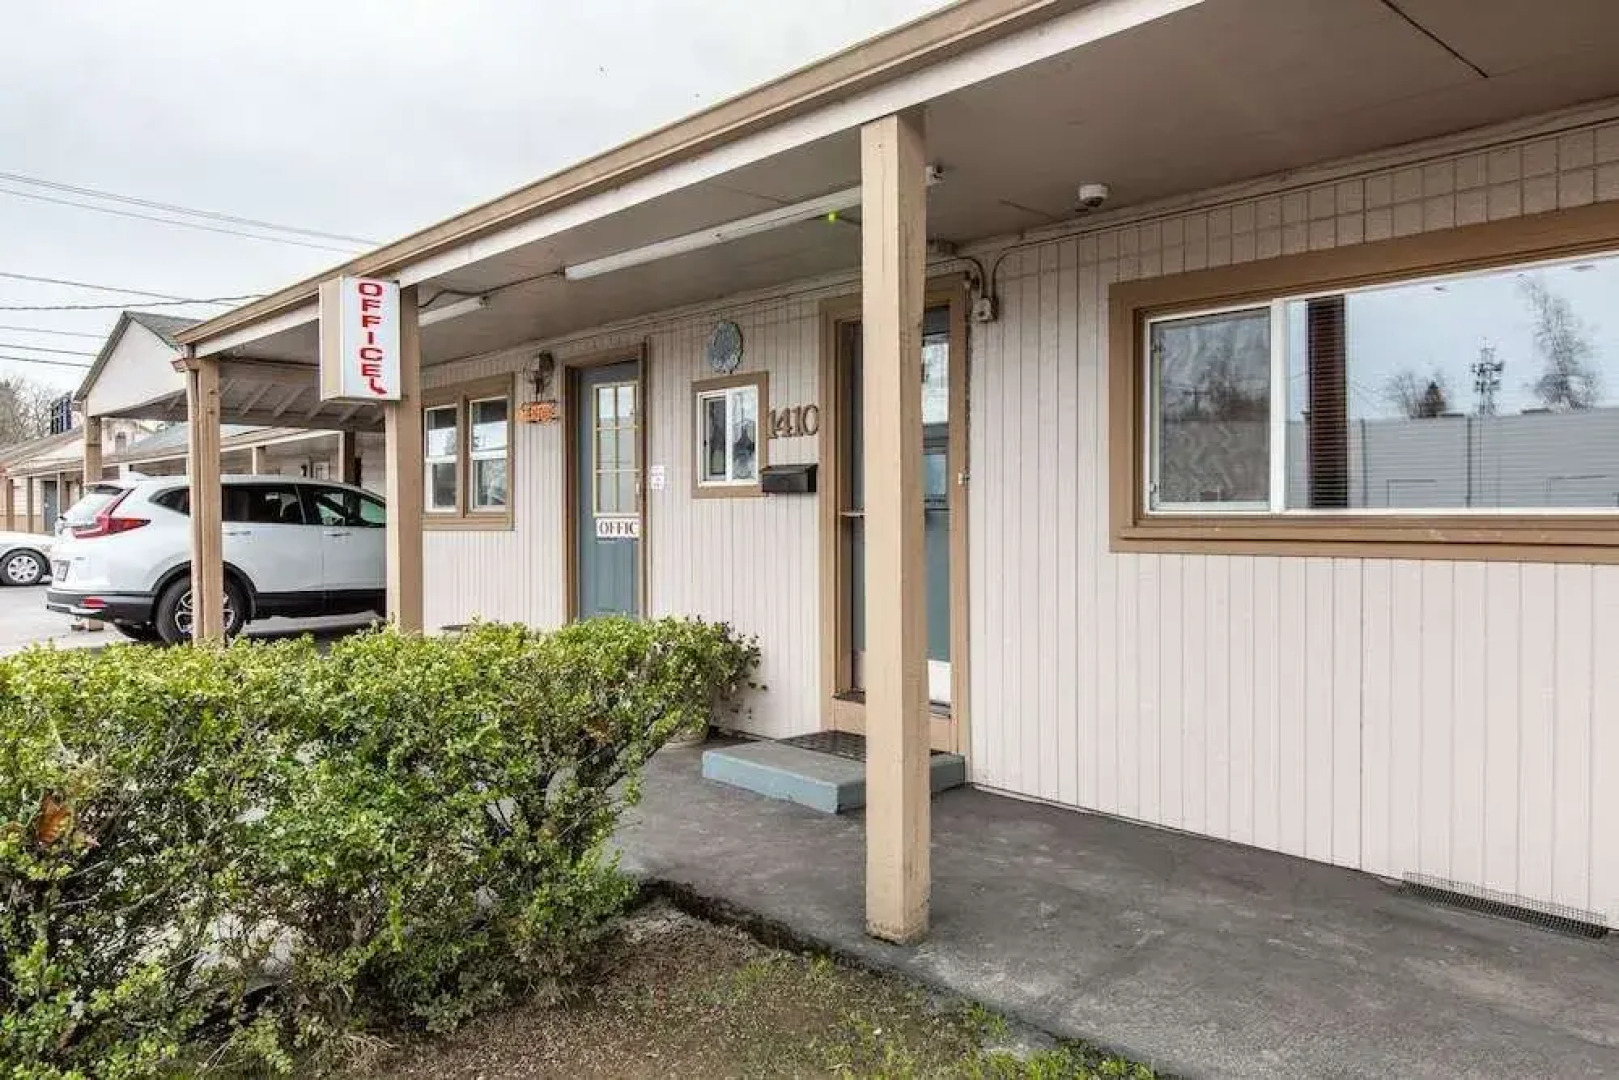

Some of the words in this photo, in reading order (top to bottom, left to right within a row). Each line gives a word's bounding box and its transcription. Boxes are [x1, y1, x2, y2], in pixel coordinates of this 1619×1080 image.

[358, 282, 383, 378] OFFICE
[766, 404, 819, 439] 1410
[599, 520, 637, 535] OFFIC
